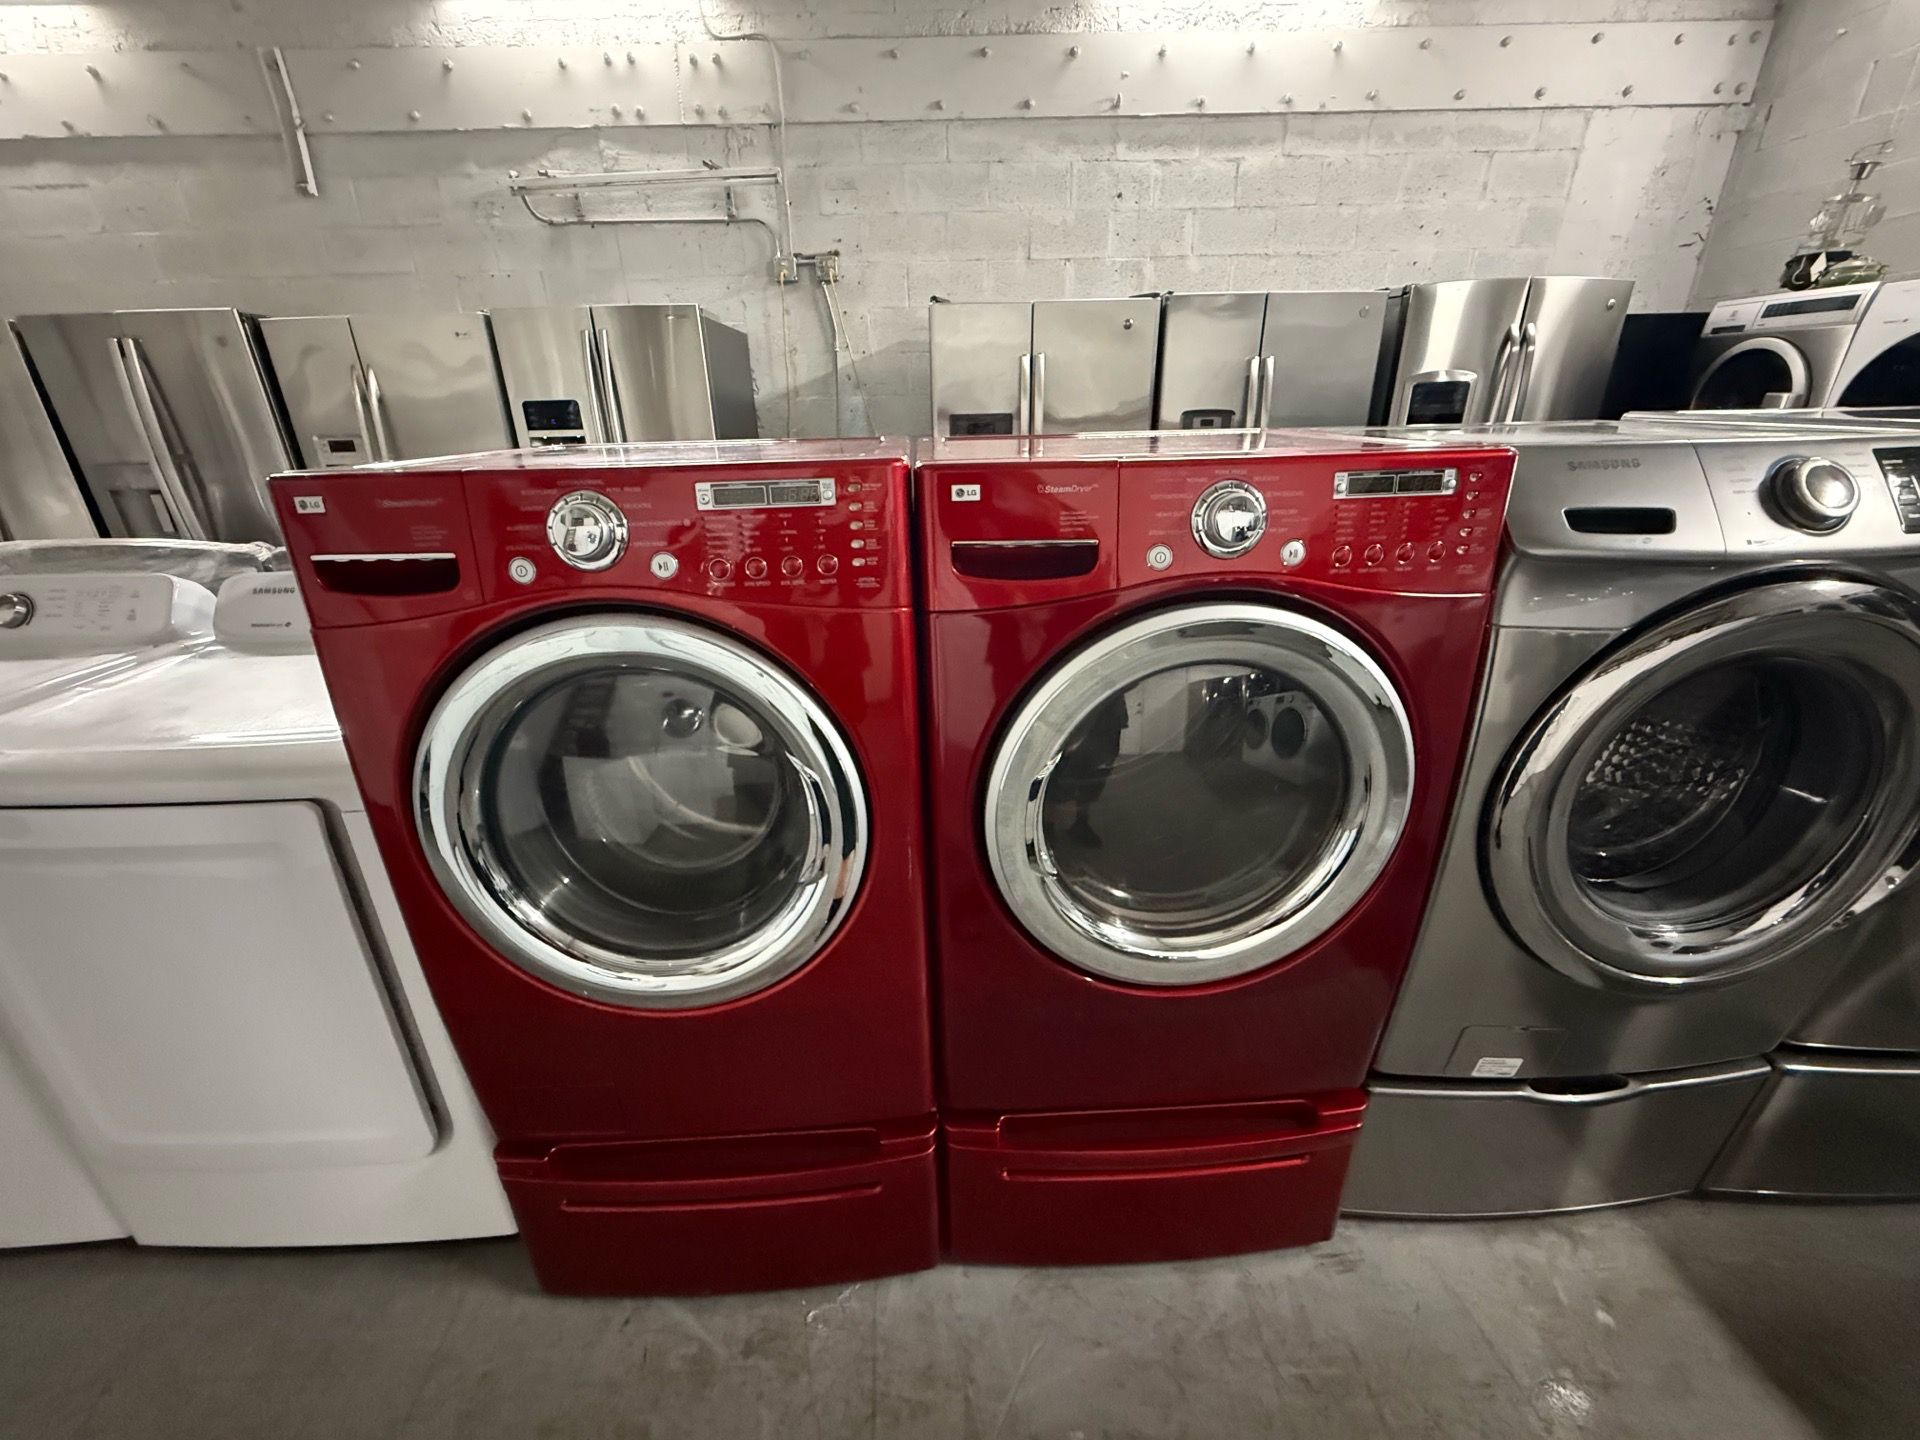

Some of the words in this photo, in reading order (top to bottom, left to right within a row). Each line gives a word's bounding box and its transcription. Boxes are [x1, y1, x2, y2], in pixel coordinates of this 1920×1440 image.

[1567, 458, 1641, 471] SAMSUNG
[308, 501, 321, 509] LG
[252, 587, 296, 596] SAMSUNG
